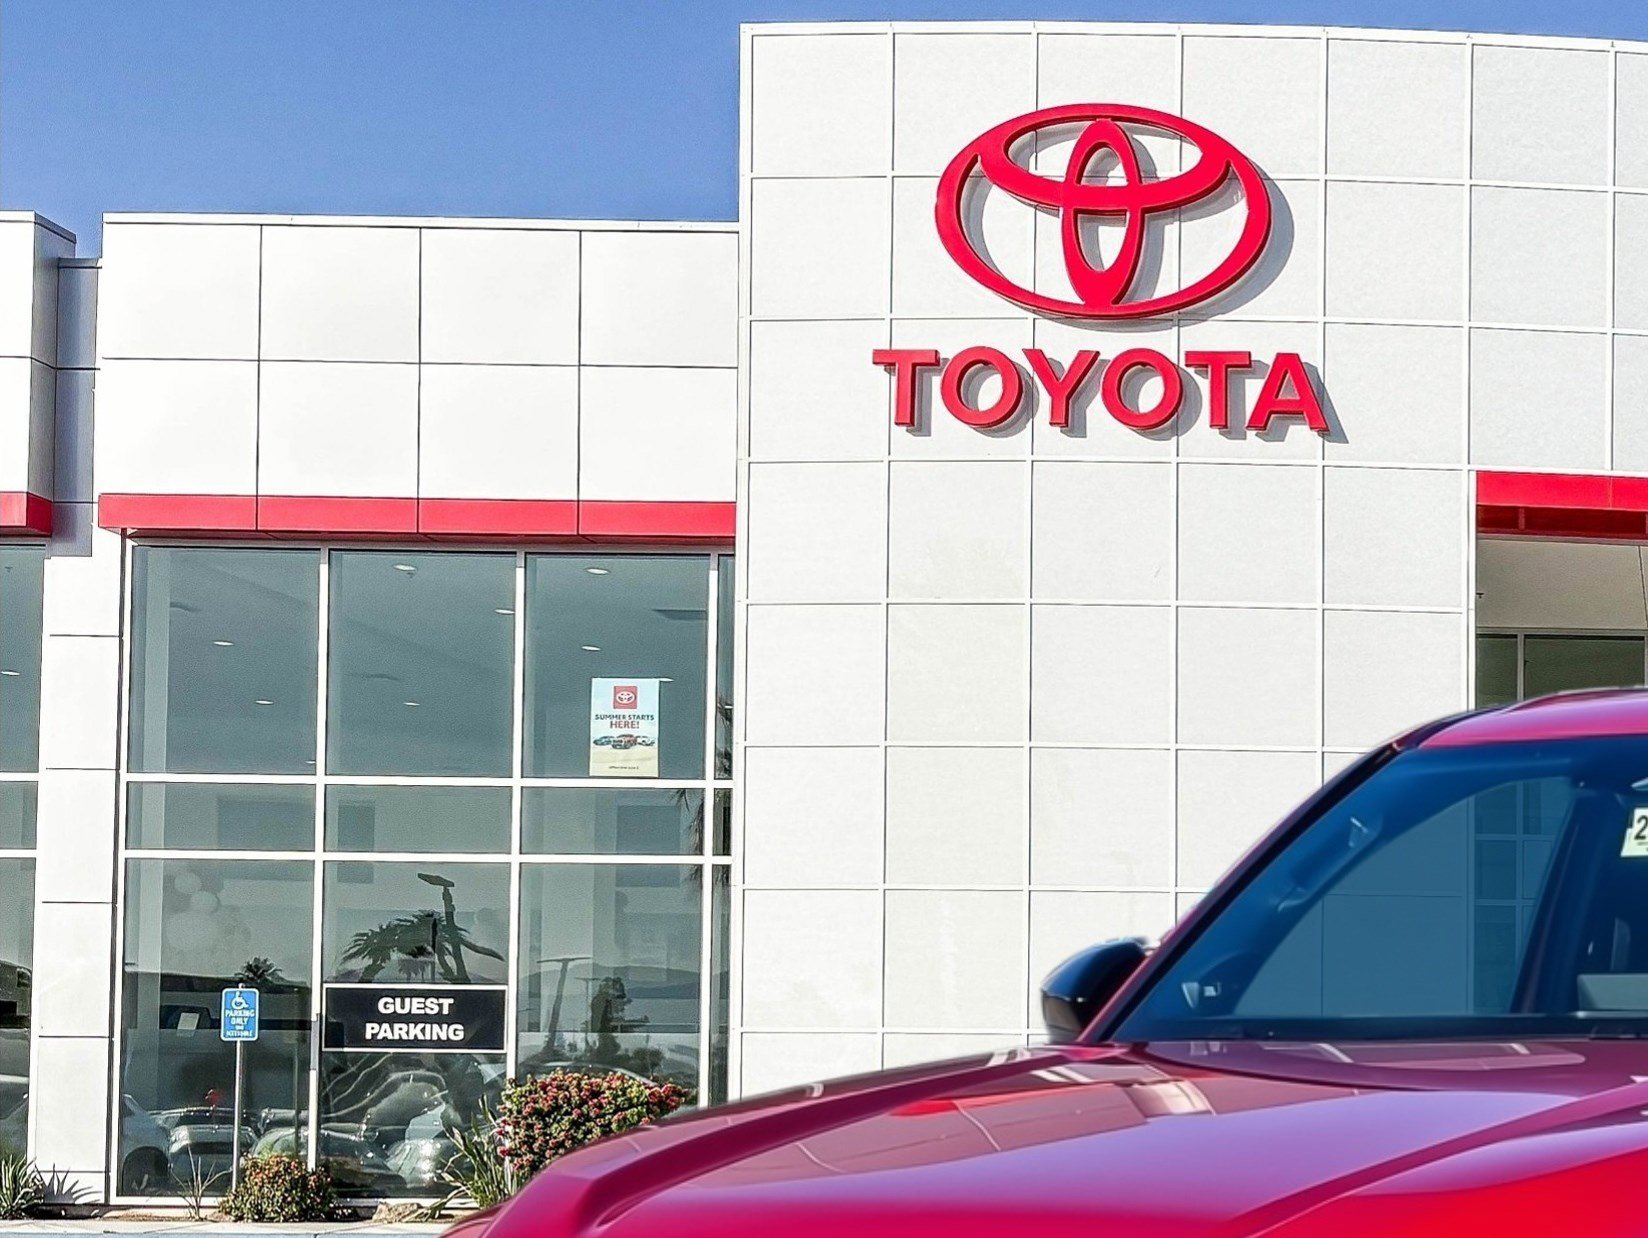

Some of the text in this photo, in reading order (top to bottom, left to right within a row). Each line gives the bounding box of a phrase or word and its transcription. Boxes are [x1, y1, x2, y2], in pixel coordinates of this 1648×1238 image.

[873, 346, 1329, 433] TOYOTA
[609, 720, 640, 729] HERE!
[377, 997, 454, 1015] GUEST
[365, 1023, 464, 1041] PARKING
